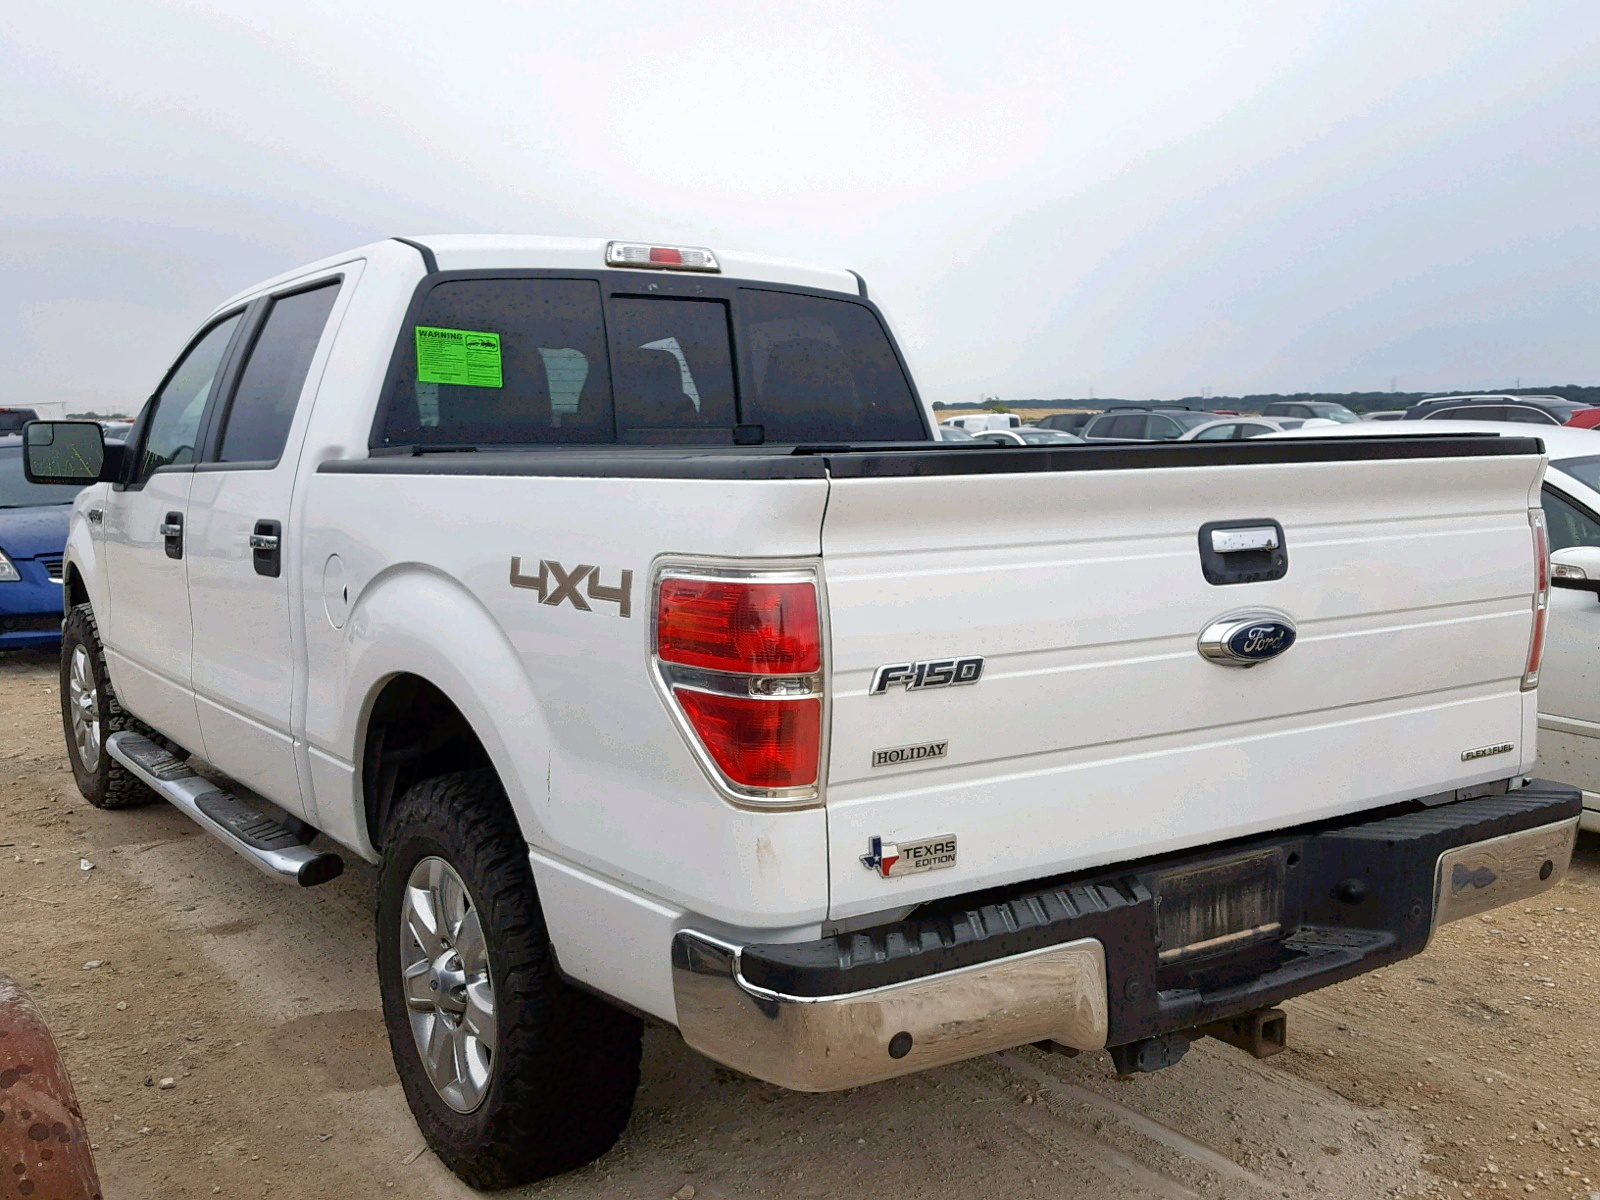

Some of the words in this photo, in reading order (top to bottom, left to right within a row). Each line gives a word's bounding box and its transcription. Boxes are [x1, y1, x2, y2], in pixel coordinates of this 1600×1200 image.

[418, 330, 463, 340] WARNING
[510, 556, 633, 618] 4X4
[1243, 626, 1285, 653] Ford
[869, 655, 985, 696] F-150
[877, 743, 946, 764] HOLIDAY
[1466, 748, 1486, 759] FLEX
[1492, 743, 1514, 754] FUEL
[903, 841, 956, 859] TEXAS
[915, 854, 956, 868] EDITION
